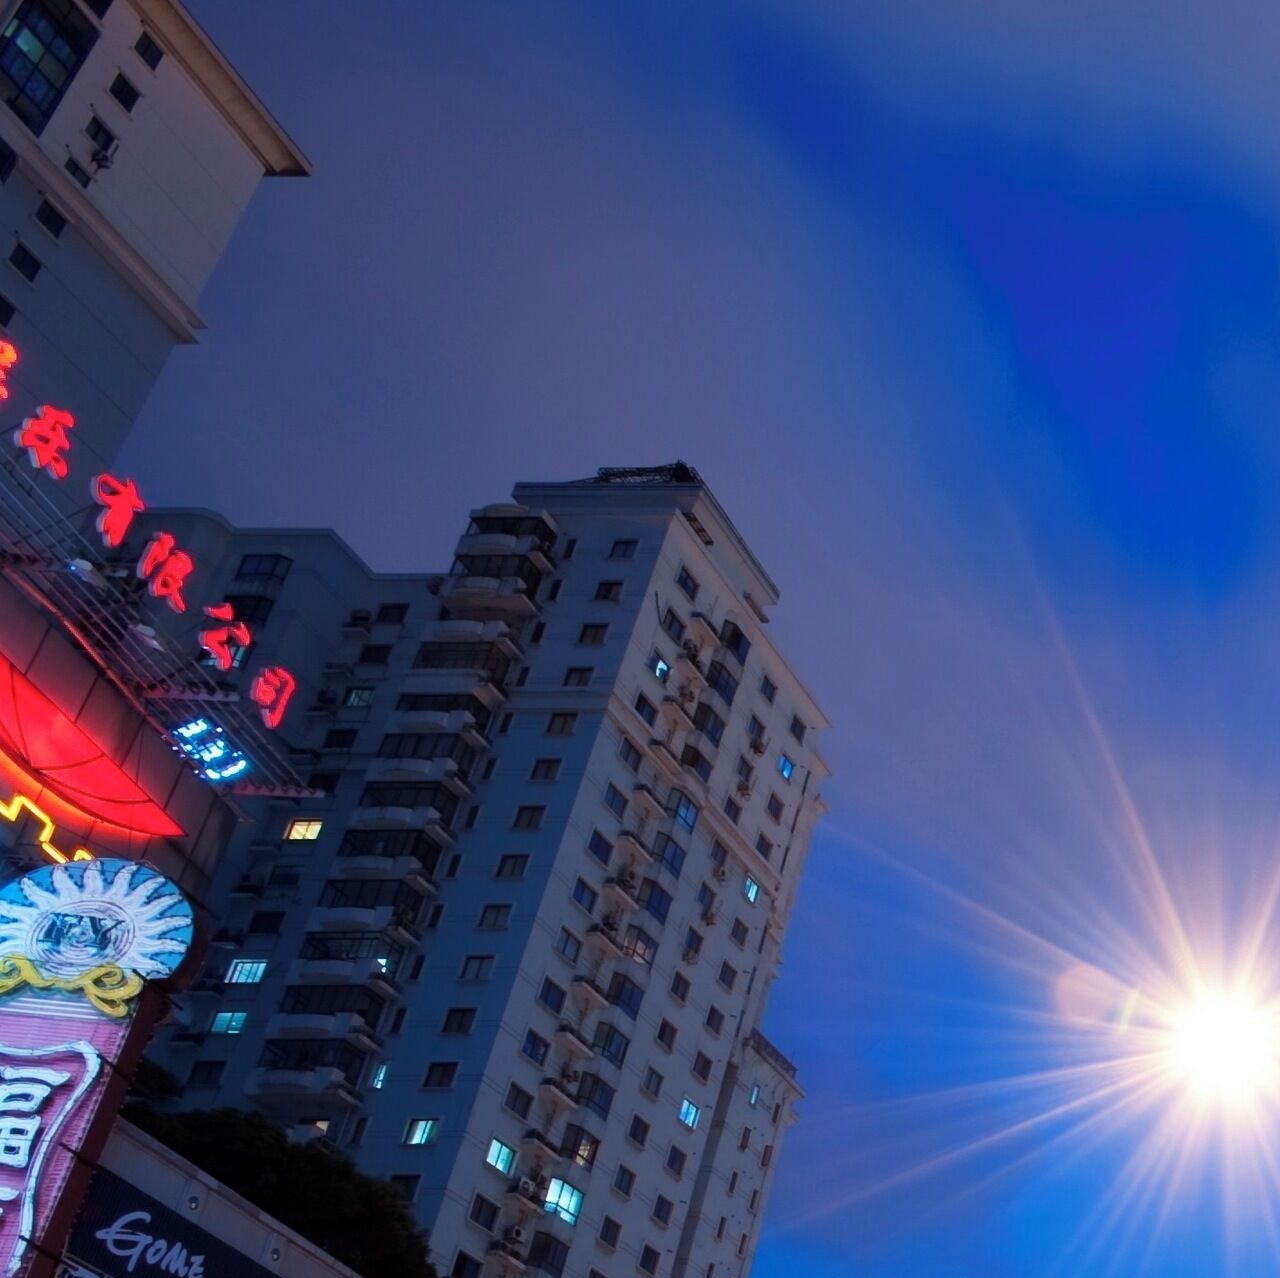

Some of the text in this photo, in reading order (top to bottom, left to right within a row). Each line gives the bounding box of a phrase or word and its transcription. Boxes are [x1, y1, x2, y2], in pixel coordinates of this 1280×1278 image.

[0, 340, 297, 729] 乐有限公司
